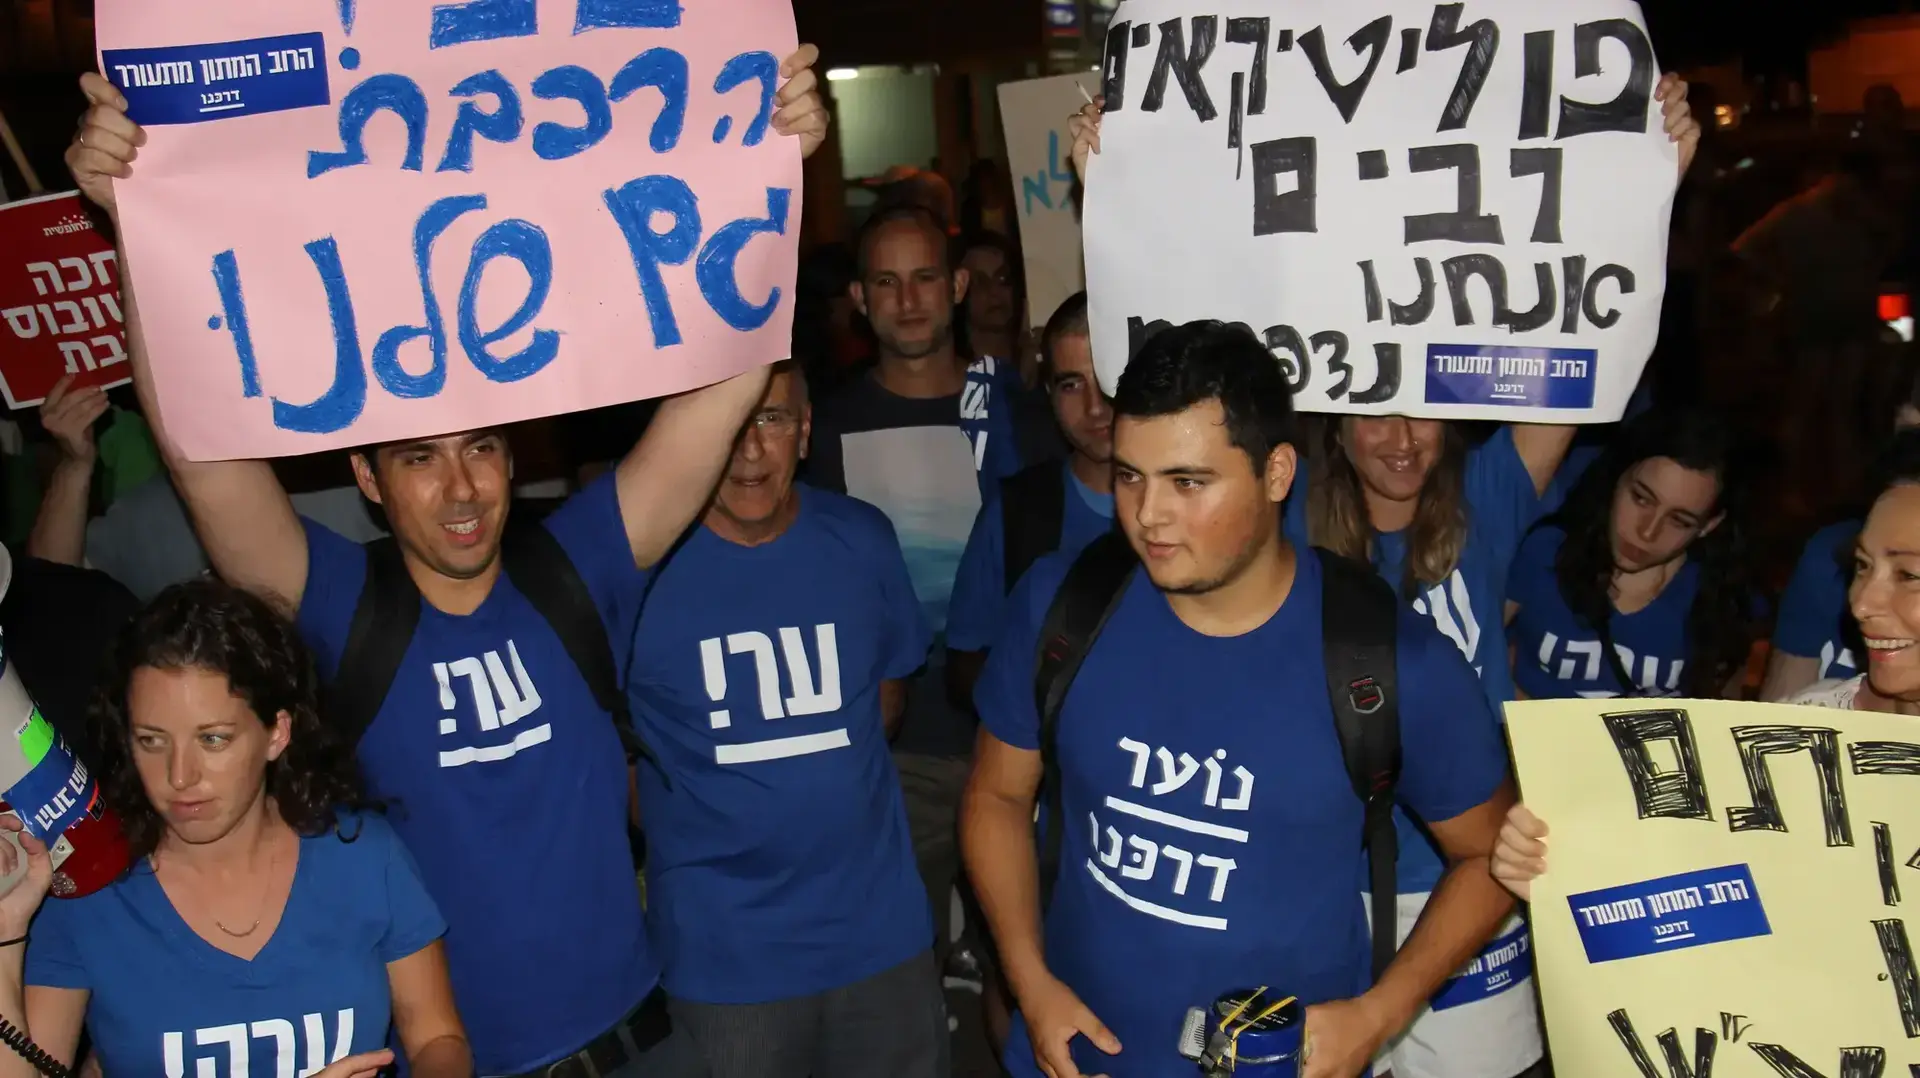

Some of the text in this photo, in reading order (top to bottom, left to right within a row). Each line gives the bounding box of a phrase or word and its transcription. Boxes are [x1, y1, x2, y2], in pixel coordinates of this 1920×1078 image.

[114, 47, 315, 88] הרוב המתון מתעורר
[307, 46, 779, 179] הרכבת
[1250, 137, 1564, 246] רבים
[26, 250, 119, 297] חכה
[1355, 254, 1636, 334] אנחנו
[57, 331, 129, 374] בת
[1433, 354, 1588, 378] הרוב המתון מתעורר
[1578, 878, 1750, 927] הרוב המתון מתעורר
